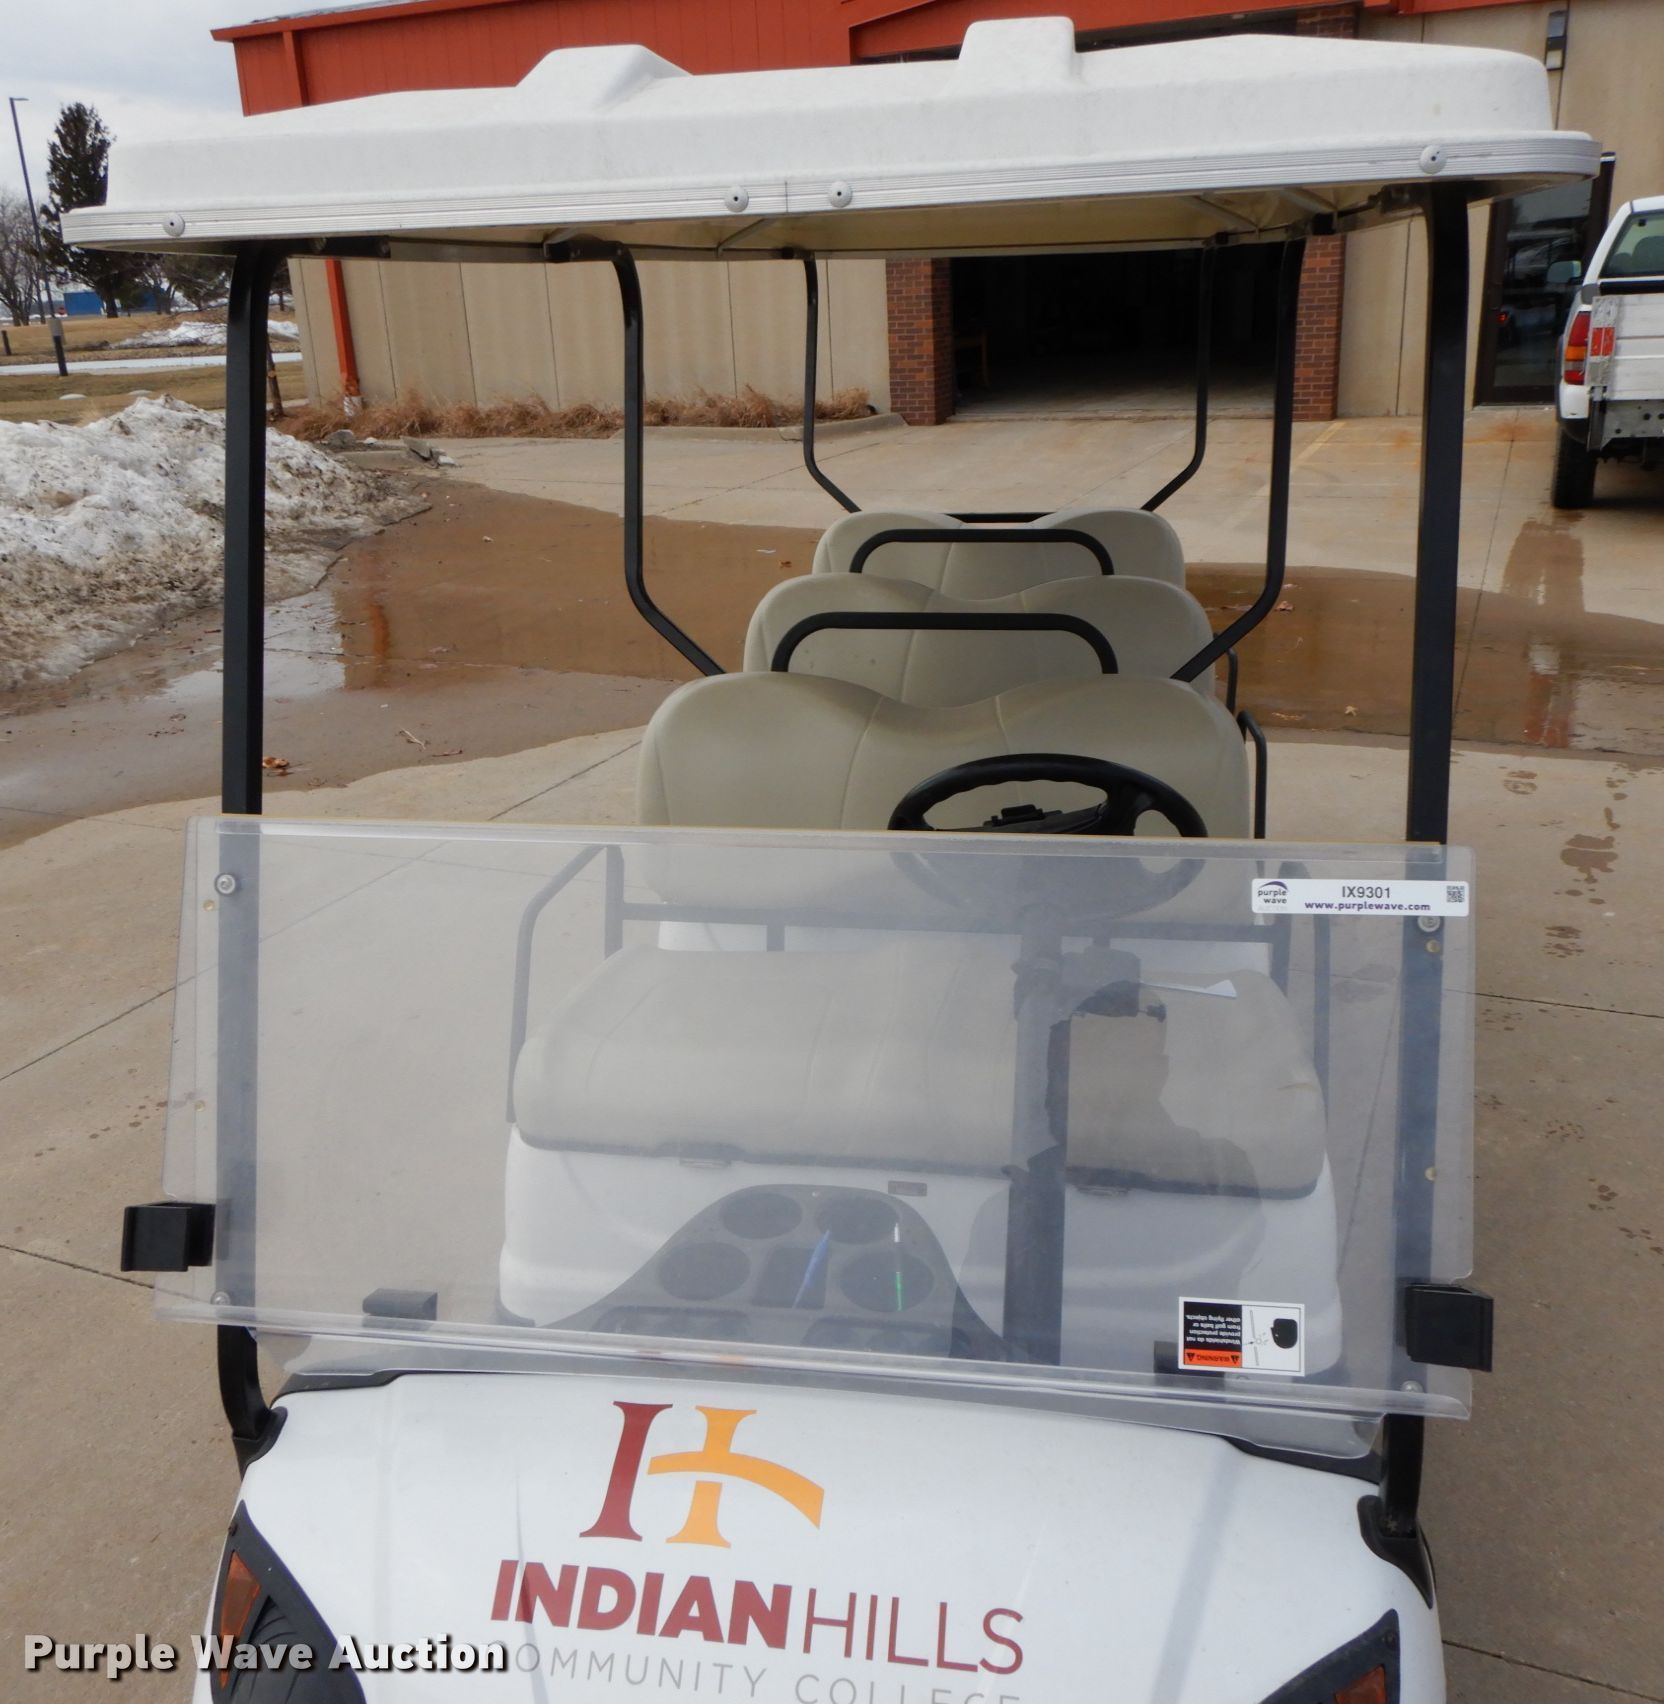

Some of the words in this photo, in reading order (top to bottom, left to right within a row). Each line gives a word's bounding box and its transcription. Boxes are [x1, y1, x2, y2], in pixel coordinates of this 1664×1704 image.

[1257, 888, 1287, 897] purple
[1341, 885, 1391, 899] IX9301
[1304, 900, 1431, 911] www.purplewave.com
